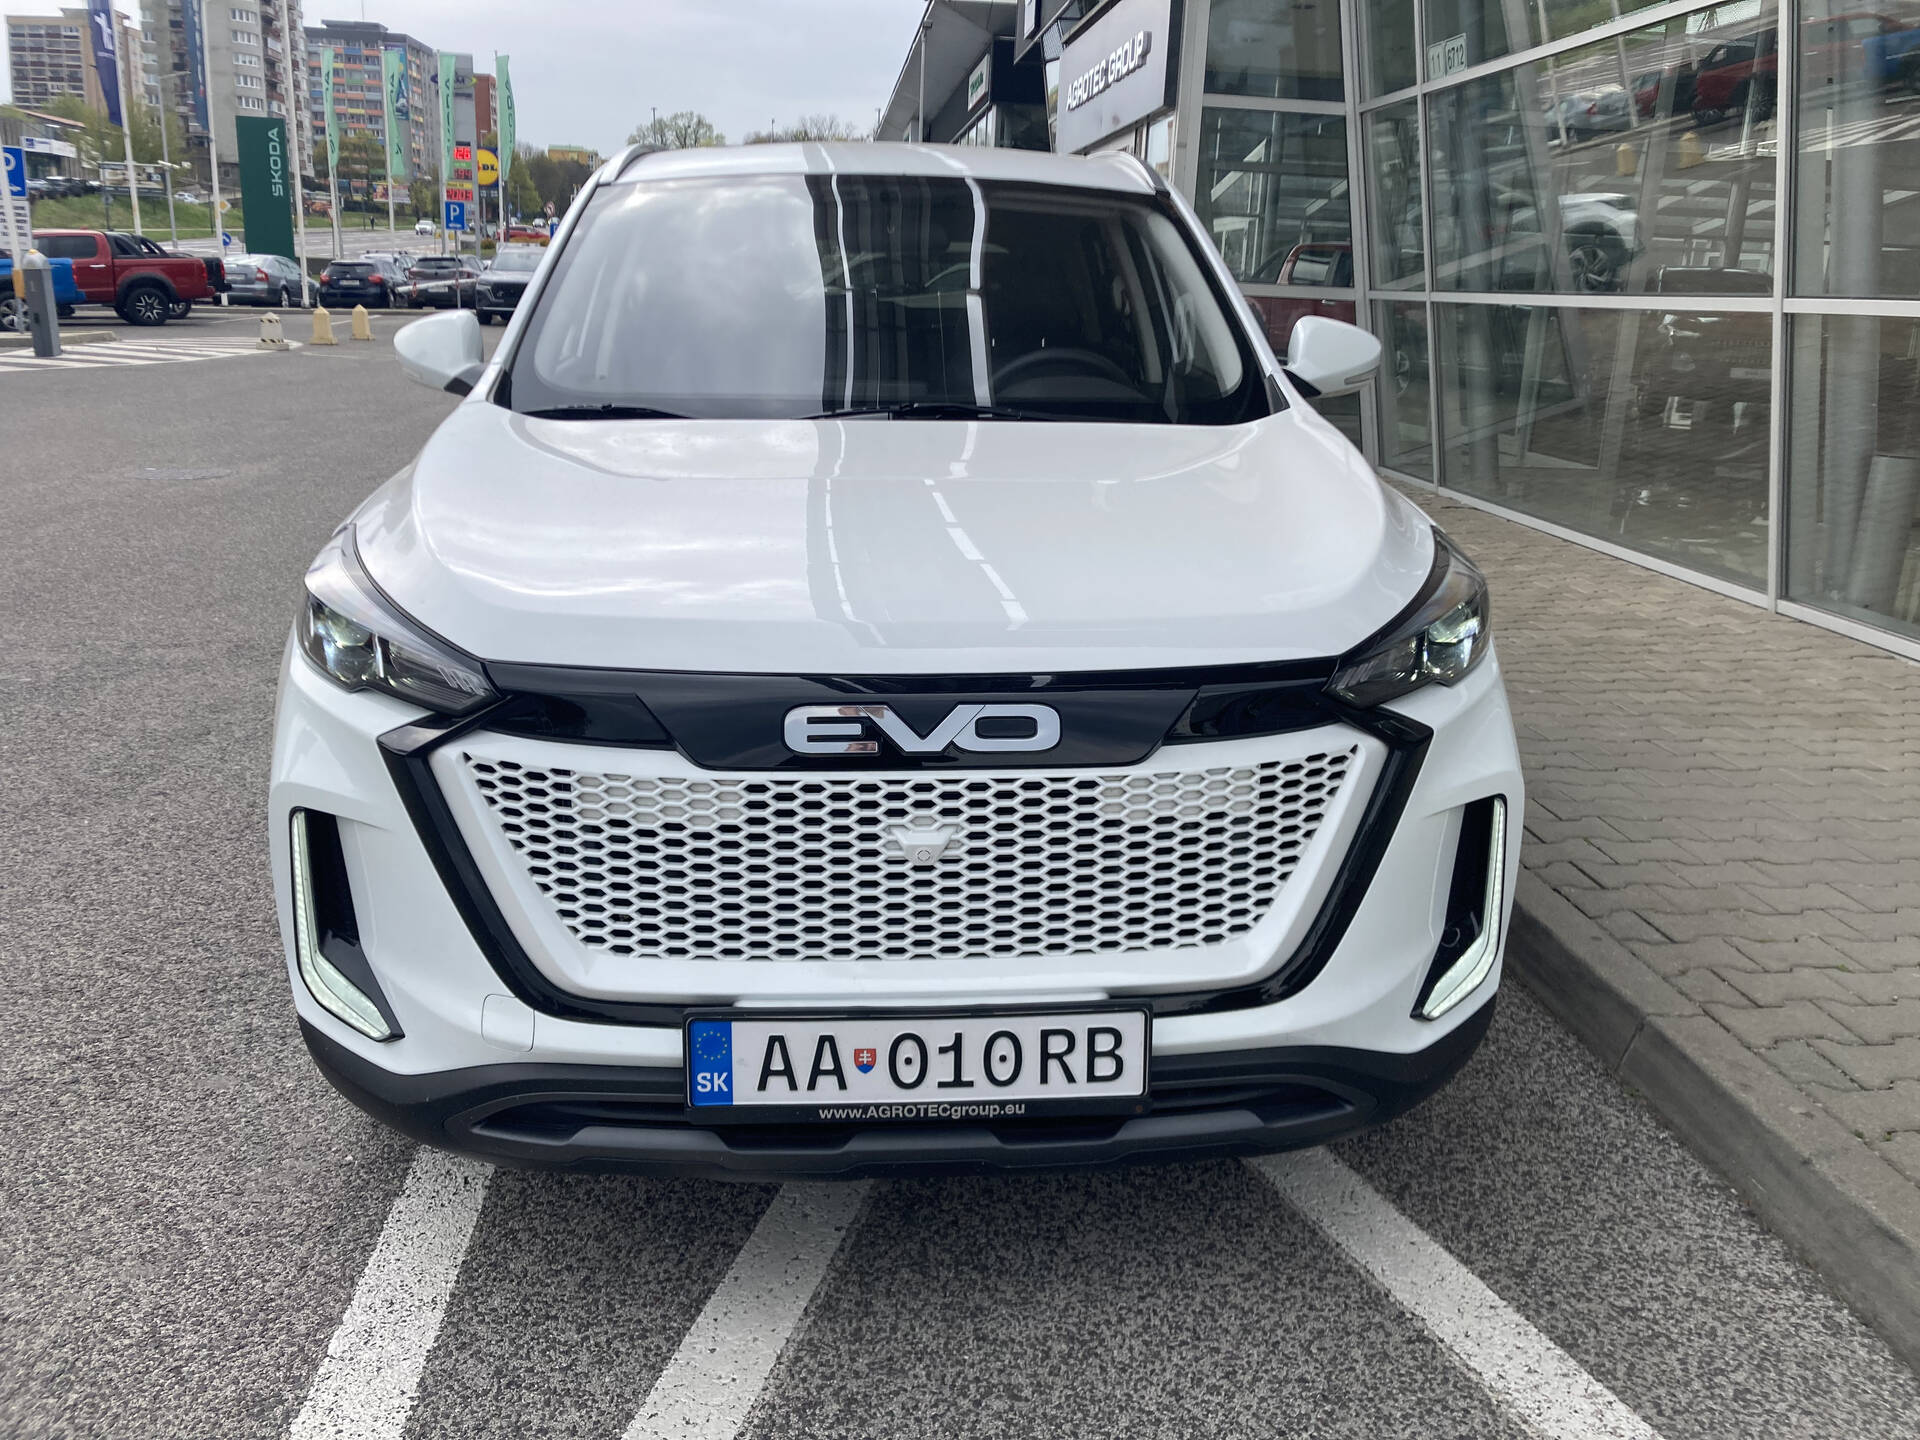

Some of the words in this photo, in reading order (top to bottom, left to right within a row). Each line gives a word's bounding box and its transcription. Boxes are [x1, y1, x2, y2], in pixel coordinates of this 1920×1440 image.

[1447, 43, 1464, 70] 6712
[1066, 58, 1107, 112] AGROTEC
[1107, 30, 1145, 84] GROUP
[450, 204, 460, 221] P
[784, 704, 1061, 754] EVO
[696, 1072, 728, 1093] SK
[818, 1102, 1026, 1120] www.AGROTECgroup.eu
